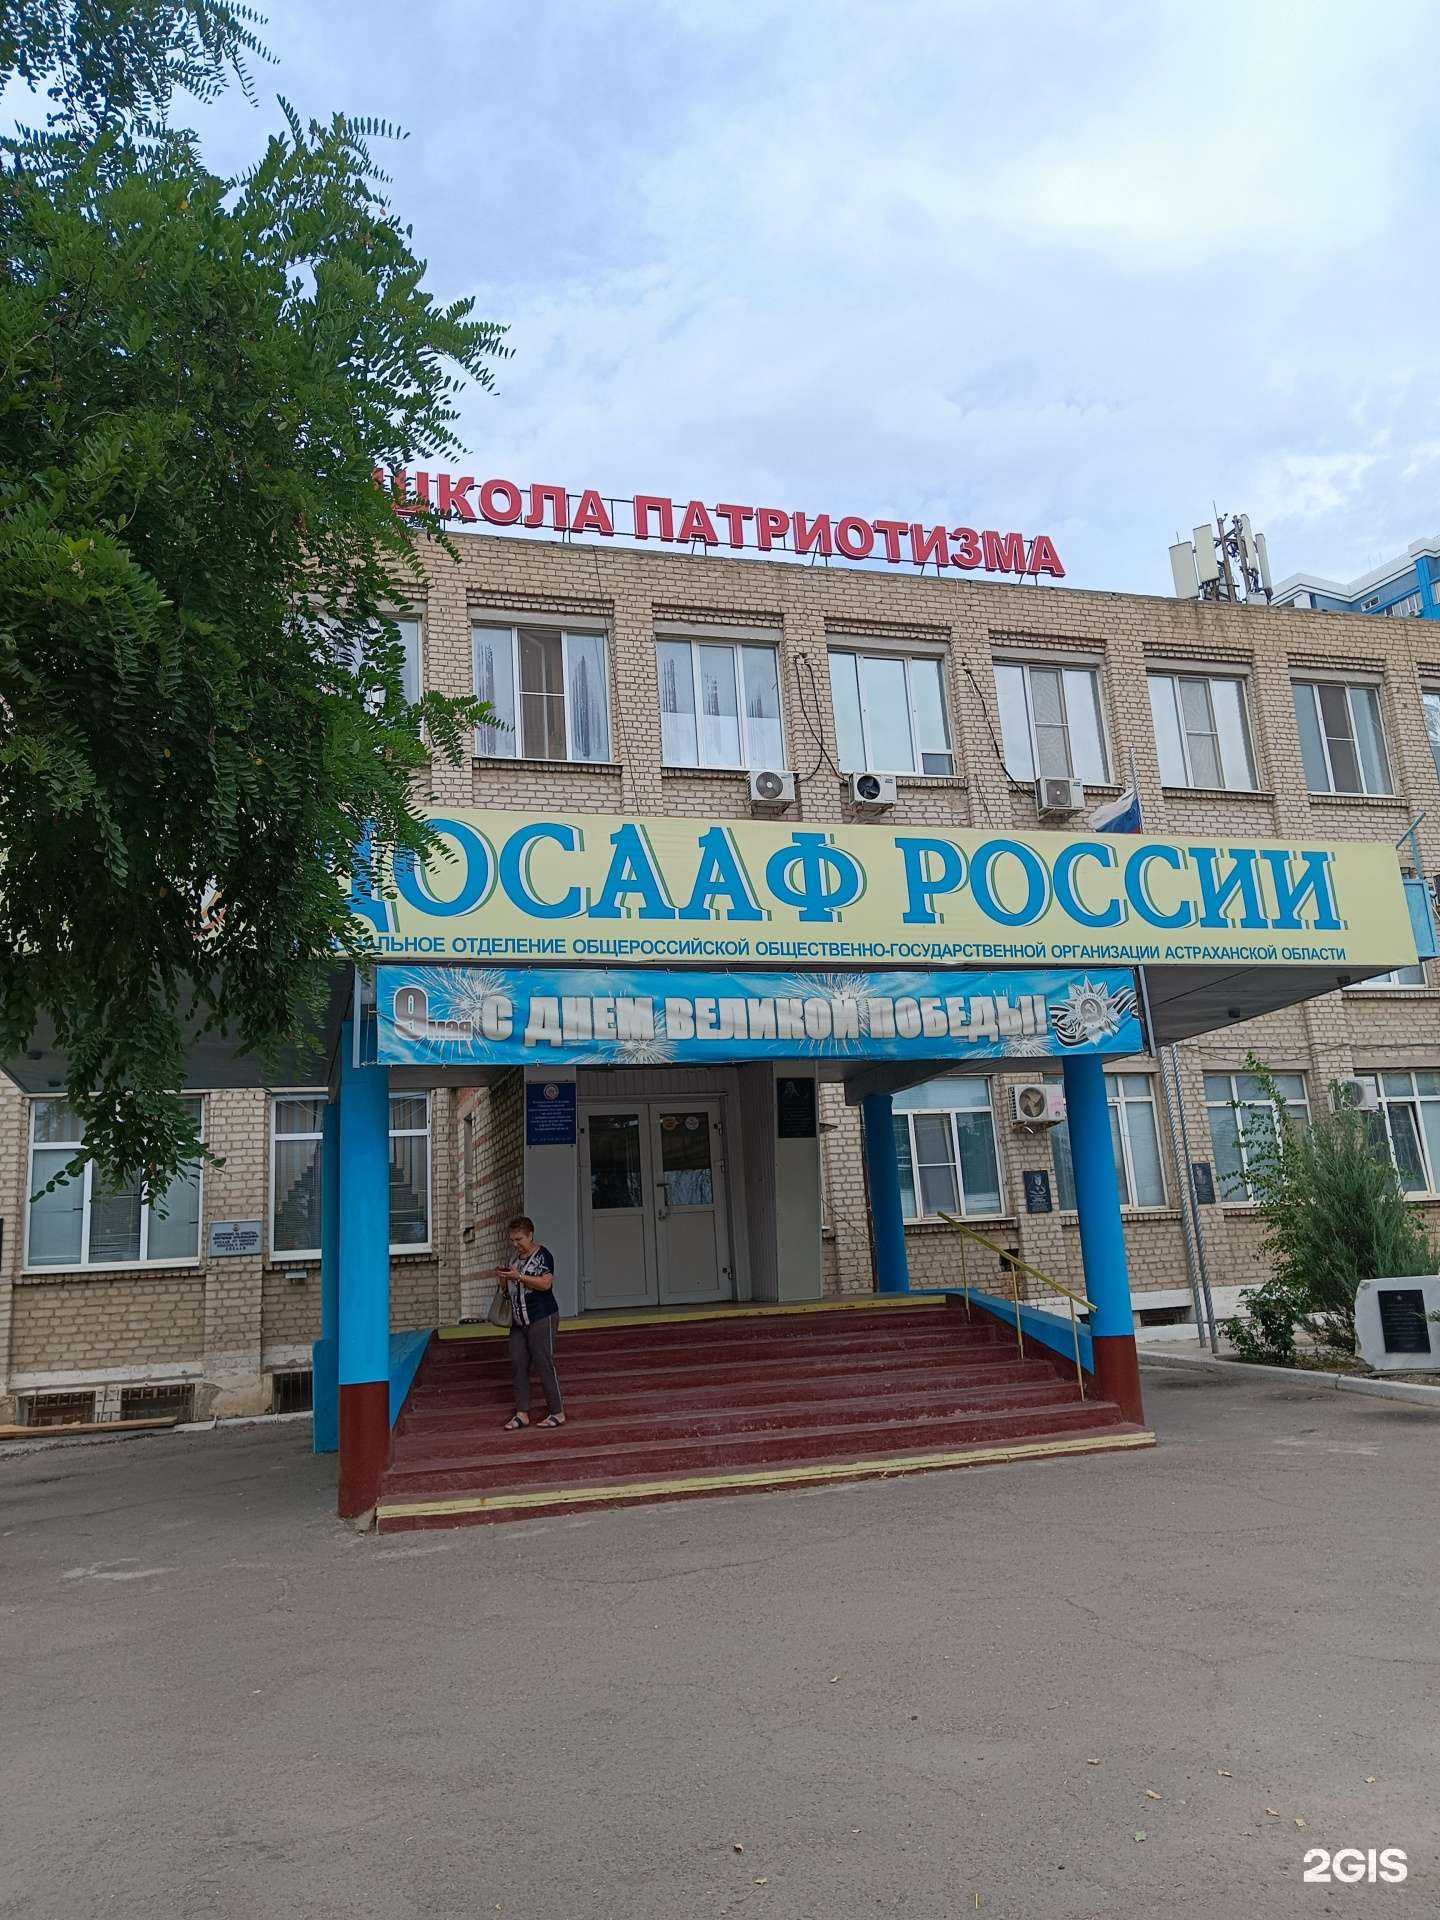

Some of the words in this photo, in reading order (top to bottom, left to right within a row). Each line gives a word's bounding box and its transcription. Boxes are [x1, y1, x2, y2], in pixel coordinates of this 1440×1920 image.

[371, 467, 614, 537] ШКОЛА
[633, 494, 1066, 578] ПАТРИОТИЗМА
[893, 837, 1348, 930] РОССИИ
[451, 937, 567, 956] ОТДЕЛЕНИЕ
[572, 936, 751, 958] ОБЩЕРОССИЙСКОЙ
[755, 938, 1047, 960] ОБЩЕСТВЕННО-ГОСУДАРСТВЕННОЙ
[1051, 943, 1161, 961] ОРГАНИЗАЦИИ
[1165, 943, 1278, 961] АСТРАХАНСКОЙ
[1281, 945, 1347, 961] ОБЛАСТИ
[394, 985, 428, 1042] 9
[481, 995, 514, 1042] С
[524, 996, 655, 1047] ДНЕМ
[867, 994, 1048, 1044] ПОБЕДЫ!
